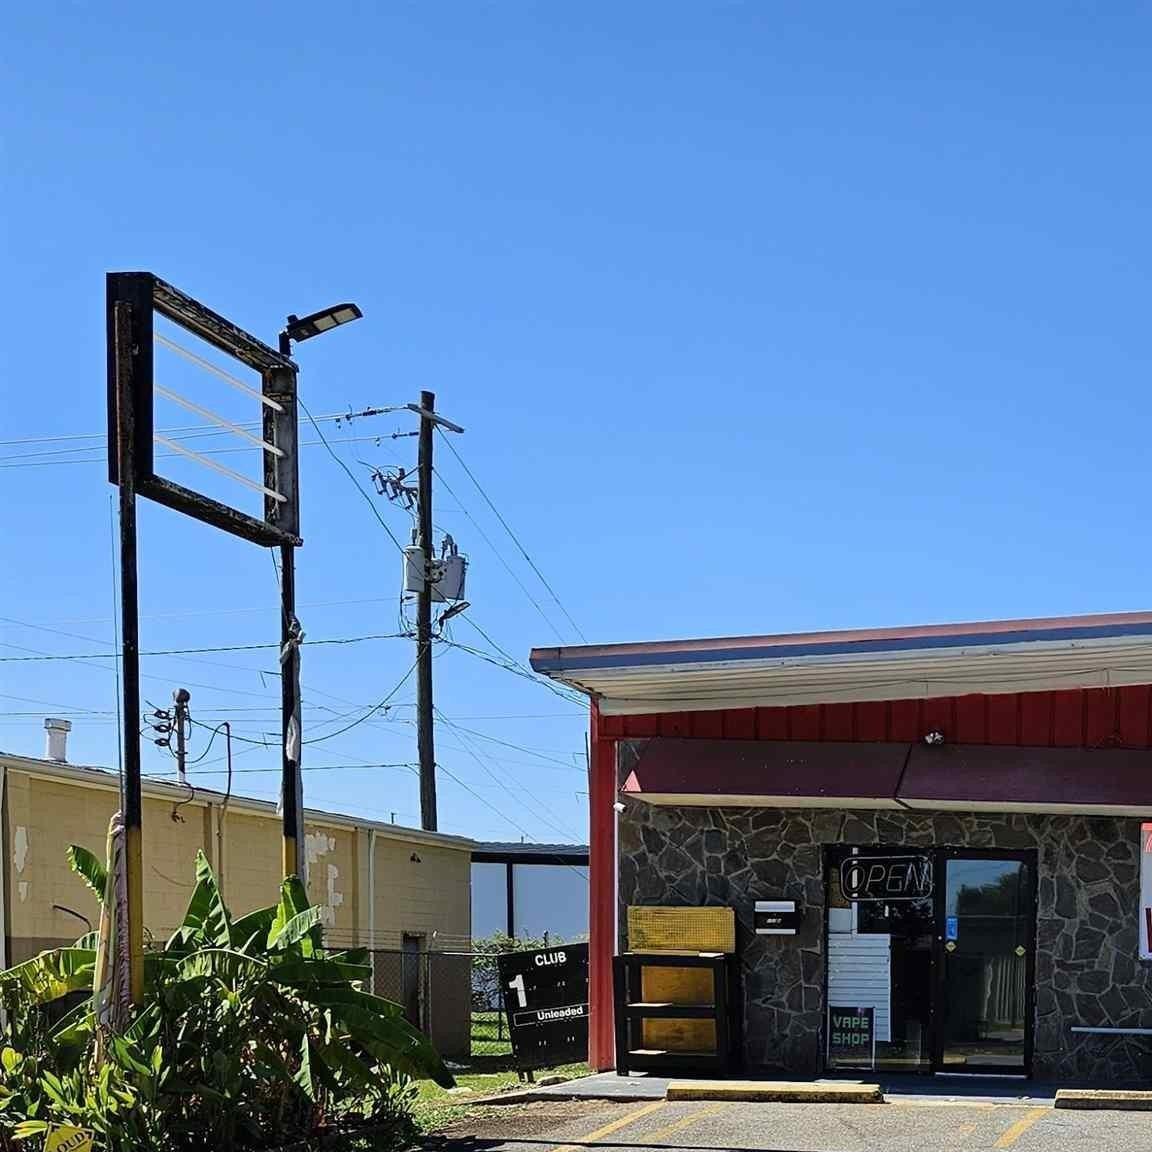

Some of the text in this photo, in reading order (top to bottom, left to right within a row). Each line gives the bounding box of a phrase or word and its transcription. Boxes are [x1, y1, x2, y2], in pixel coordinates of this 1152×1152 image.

[846, 864, 927, 892] OPEN
[534, 951, 568, 967] CLUB
[508, 973, 528, 1008] 1
[536, 1005, 584, 1022] Unleaded
[833, 1016, 870, 1029] VAPE
[832, 1032, 870, 1047] SHOP
